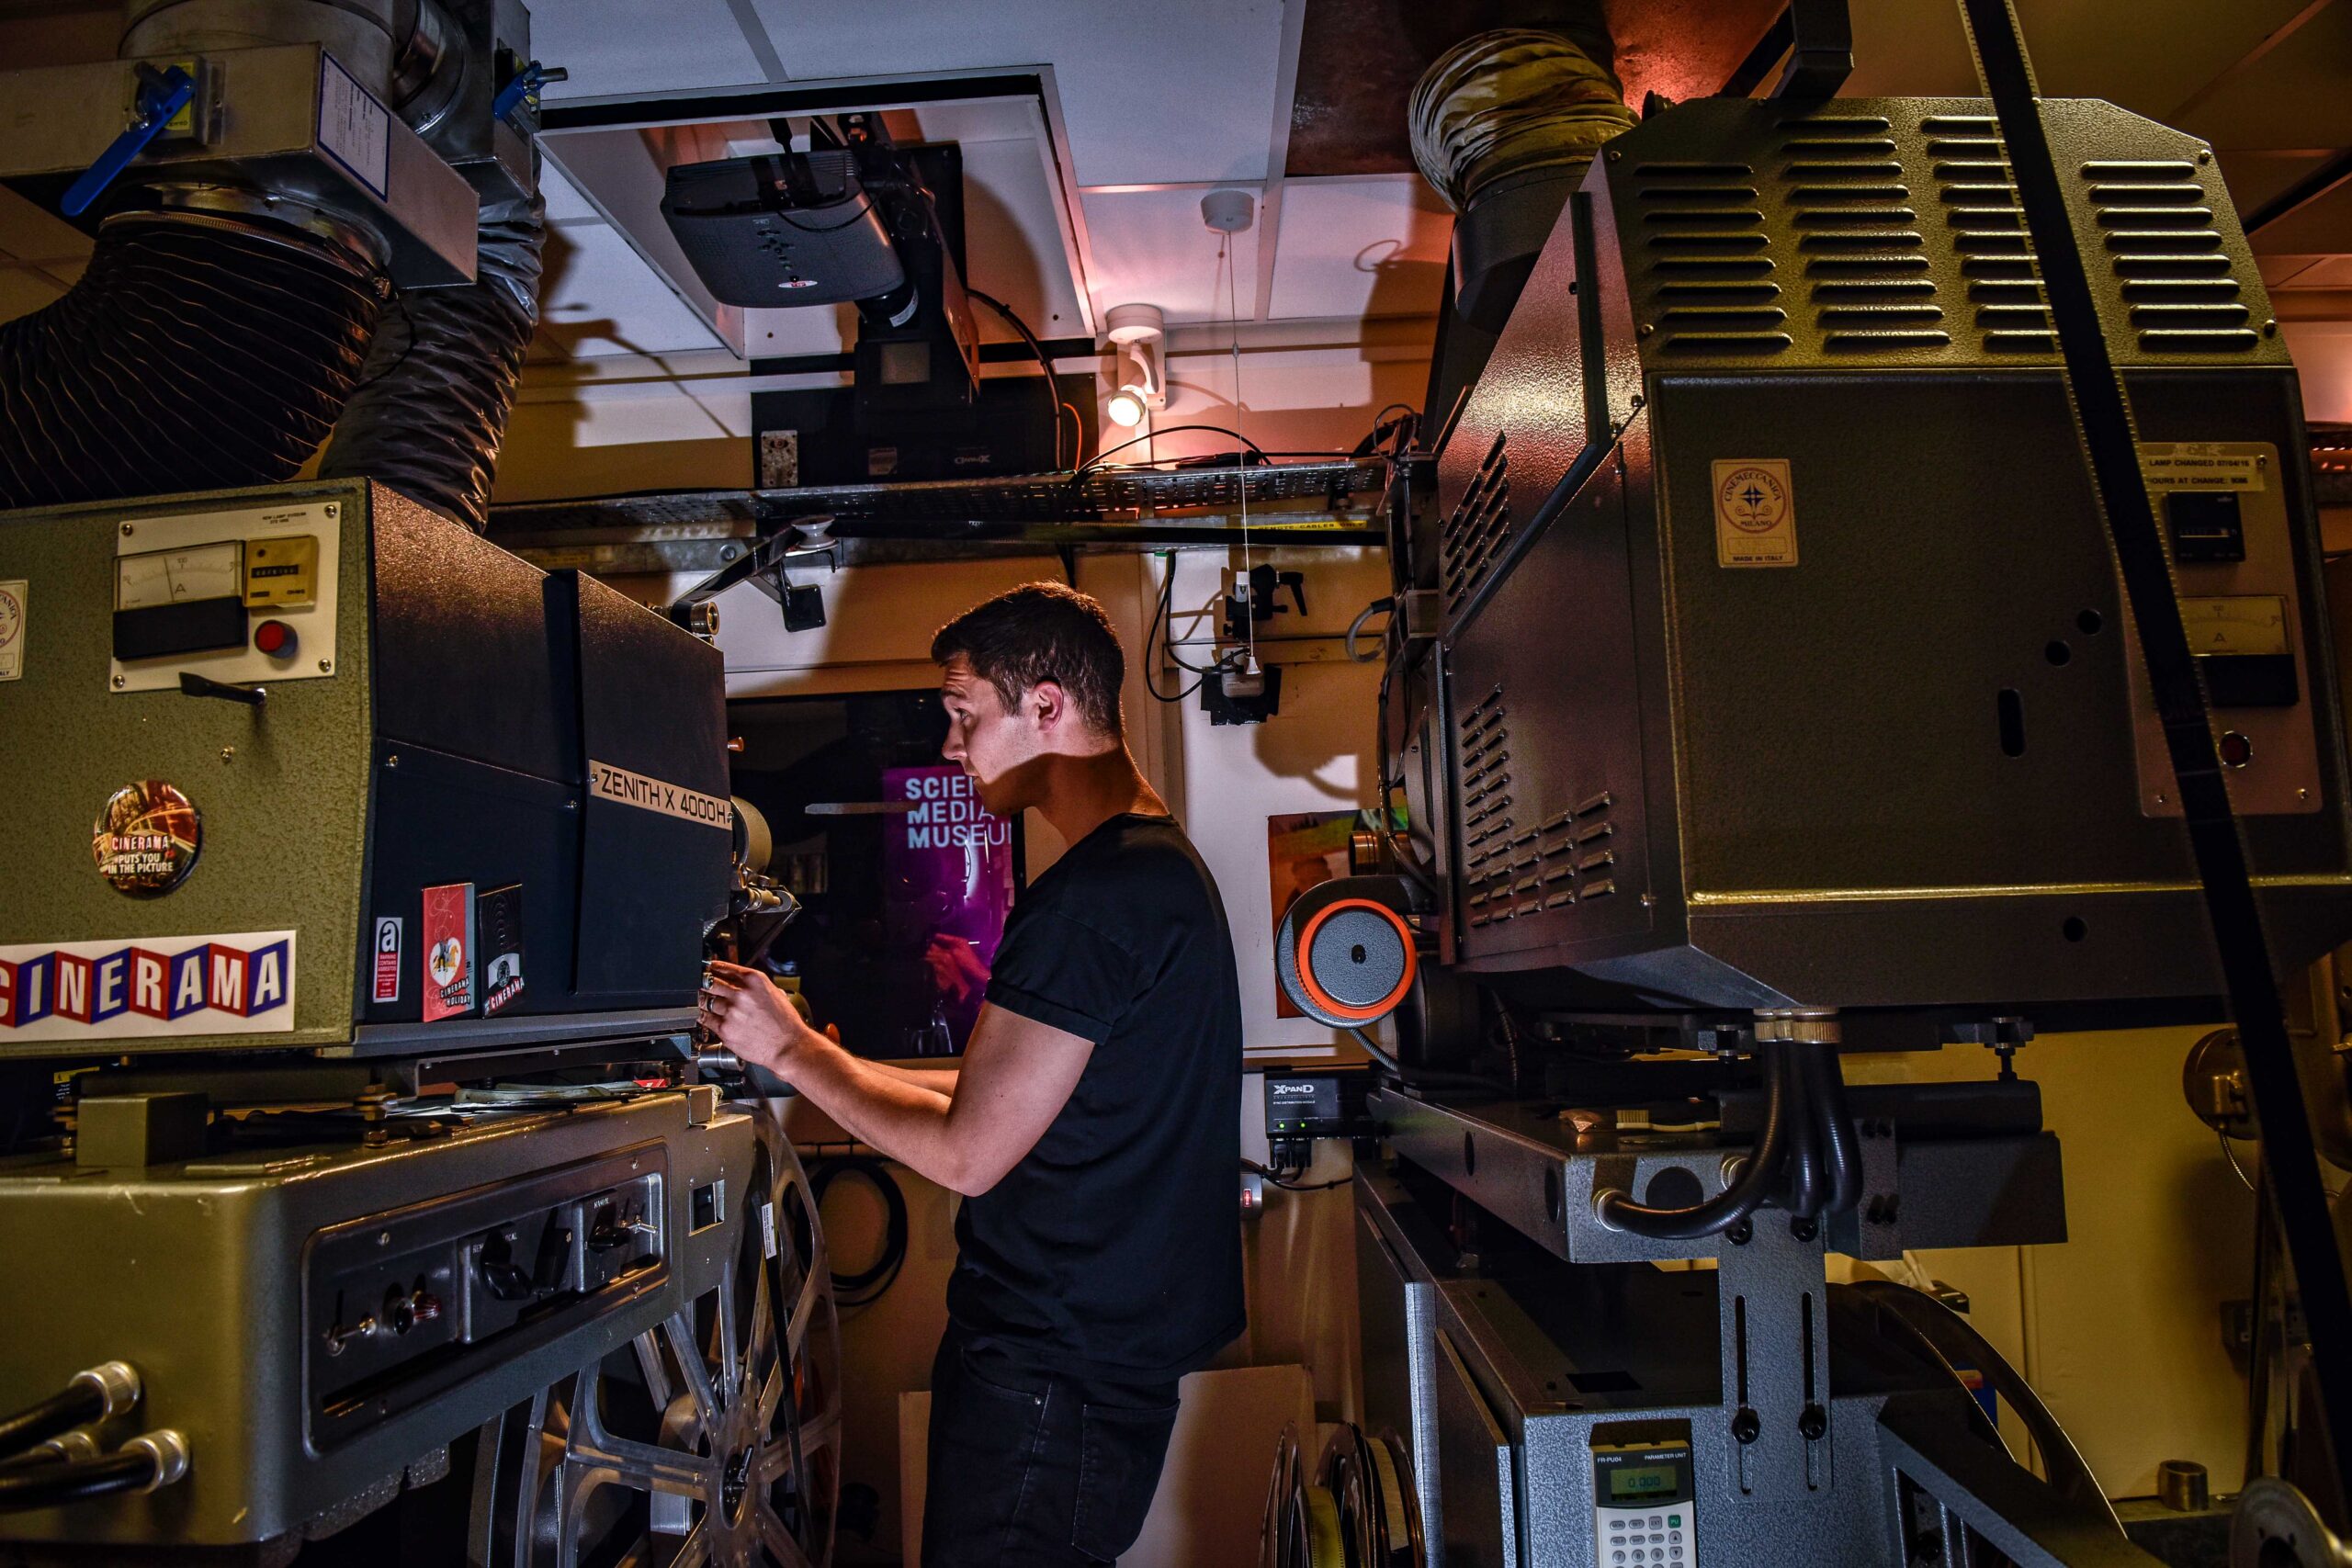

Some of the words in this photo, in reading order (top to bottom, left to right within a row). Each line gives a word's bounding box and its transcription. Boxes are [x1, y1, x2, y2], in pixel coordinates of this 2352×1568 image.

[1724, 471, 1782, 502] CINEMECCANICA
[175, 583, 186, 594] A
[2213, 632, 2226, 643] A
[601, 768, 661, 807] ZENITH
[664, 787, 675, 810] X
[680, 793, 726, 825] 4000H
[112, 836, 170, 851] CINERAMA
[908, 823, 1012, 850] MUSEU
[119, 854, 140, 863] PUTS
[142, 852, 161, 863] YOU
[107, 864, 118, 874] IN
[119, 863, 136, 874] THE
[137, 862, 174, 873] PICTURE
[381, 921, 397, 953] a
[441, 976, 469, 998] CINERAMA
[491, 977, 525, 1010] CINERAMA
[447, 995, 471, 1007] HOLIDAY
